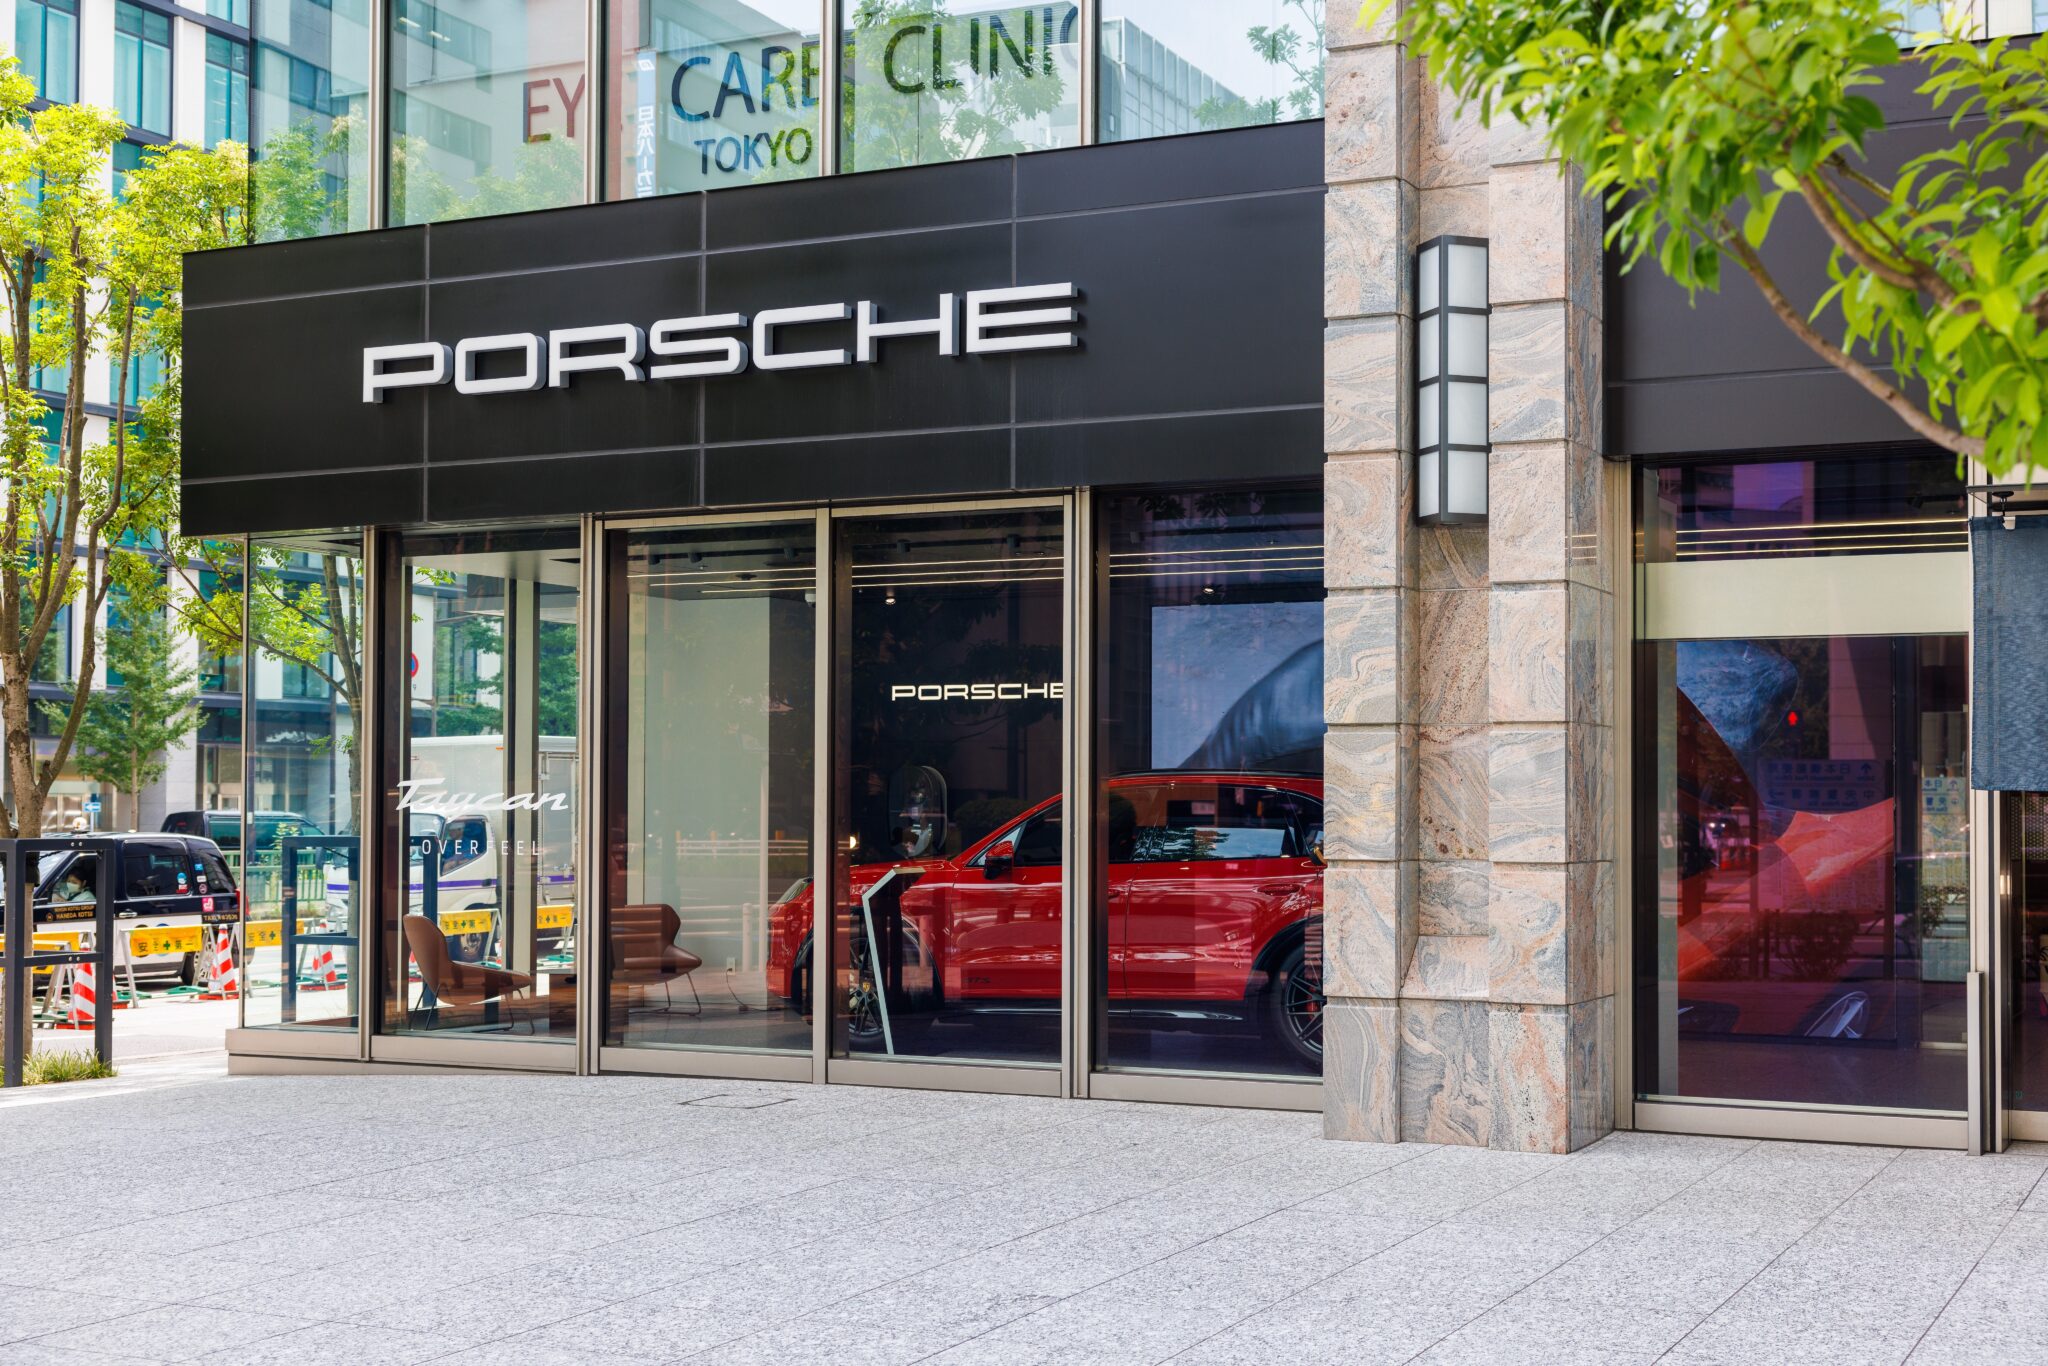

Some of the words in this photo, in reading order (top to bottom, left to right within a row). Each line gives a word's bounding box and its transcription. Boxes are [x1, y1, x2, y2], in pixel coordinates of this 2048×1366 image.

[671, 40, 820, 122] CARE
[694, 128, 812, 174] TOKYO
[362, 281, 1079, 404] PORSCHE
[396, 777, 569, 823] Taycan
[421, 839, 540, 856] OVERFEEL
